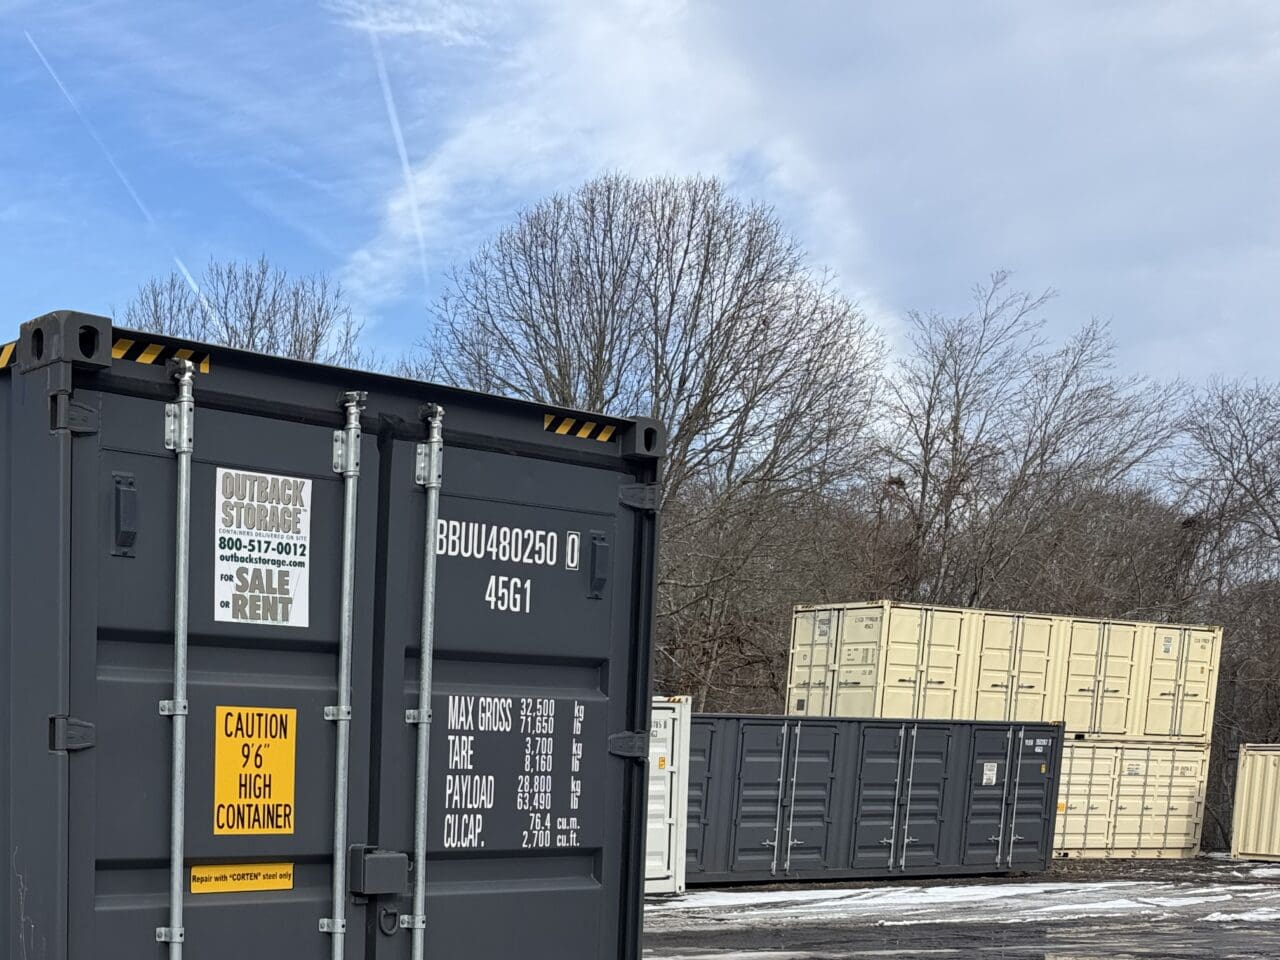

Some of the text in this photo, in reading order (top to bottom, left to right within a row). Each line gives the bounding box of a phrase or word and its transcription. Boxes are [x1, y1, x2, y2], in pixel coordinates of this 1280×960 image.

[221, 472, 305, 507] OUTBACK
[221, 501, 302, 534] STORAGE
[218, 536, 307, 557] 800-517-0012
[219, 528, 253, 537] CONTAINERS
[255, 532, 284, 540] DELIVERED
[435, 519, 580, 570] BBUU480250 0
[219, 552, 306, 569] outbackstorage.com
[220, 566, 290, 596] FOR SALE
[485, 575, 531, 613] 45G1
[219, 593, 293, 622] OR RENT
[224, 712, 288, 739] CAUTION
[448, 695, 585, 732] MAX GROSS 32,500 kg
[520, 716, 581, 735] 71,650 lb
[241, 743, 270, 768] 9'6"
[448, 735, 583, 770] TARE 3,700 kg
[524, 755, 580, 773] 8,160 lb
[238, 773, 272, 800] HIGH
[445, 774, 581, 809] PAYLOAD 28,800 kg
[516, 792, 579, 811] 63,490 lb
[216, 803, 292, 829] CONTAINER
[443, 813, 581, 848] CU.CAP. 76.4 cu.m.
[522, 830, 580, 848] 2,700 cu.ft.
[192, 874, 213, 884] Repair
[214, 874, 228, 882] with
[262, 872, 278, 881] steel
[279, 871, 292, 881] only
